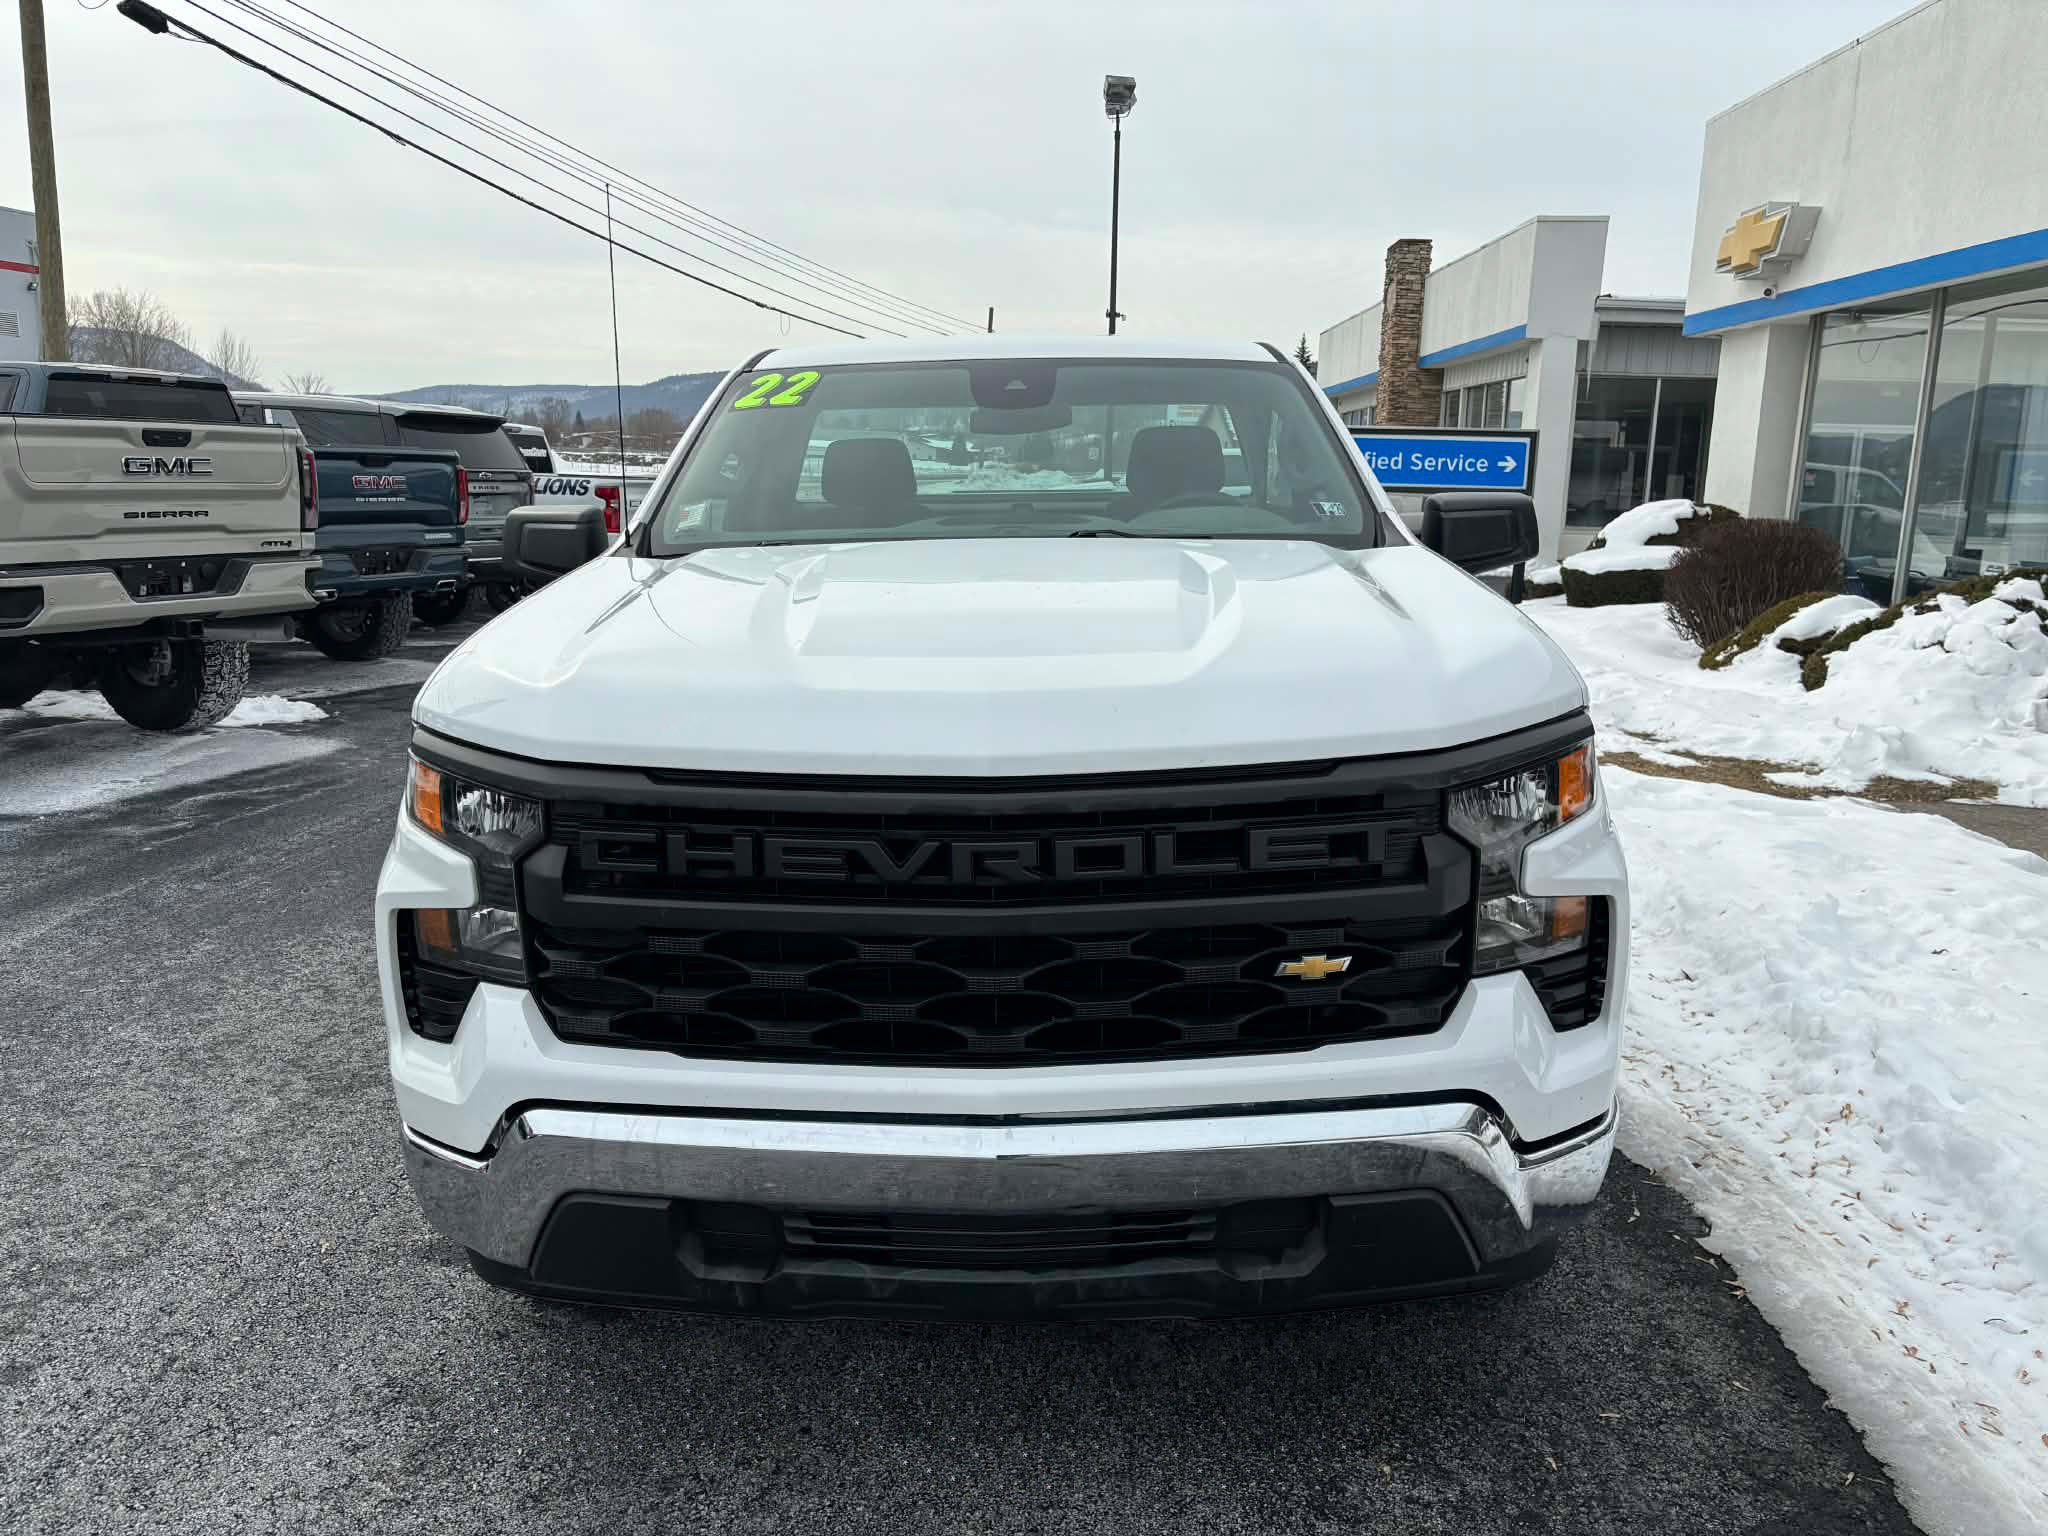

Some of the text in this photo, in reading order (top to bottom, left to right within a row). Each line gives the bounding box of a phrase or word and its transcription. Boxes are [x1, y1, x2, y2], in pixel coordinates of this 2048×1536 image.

[734, 370, 821, 410] 22
[121, 456, 214, 477] GMC
[1410, 453, 1489, 473] Service
[352, 475, 408, 489] GMC
[534, 477, 591, 497] LIONS
[123, 510, 209, 519] SIERRA
[579, 819, 1414, 882] CHEVROLET
